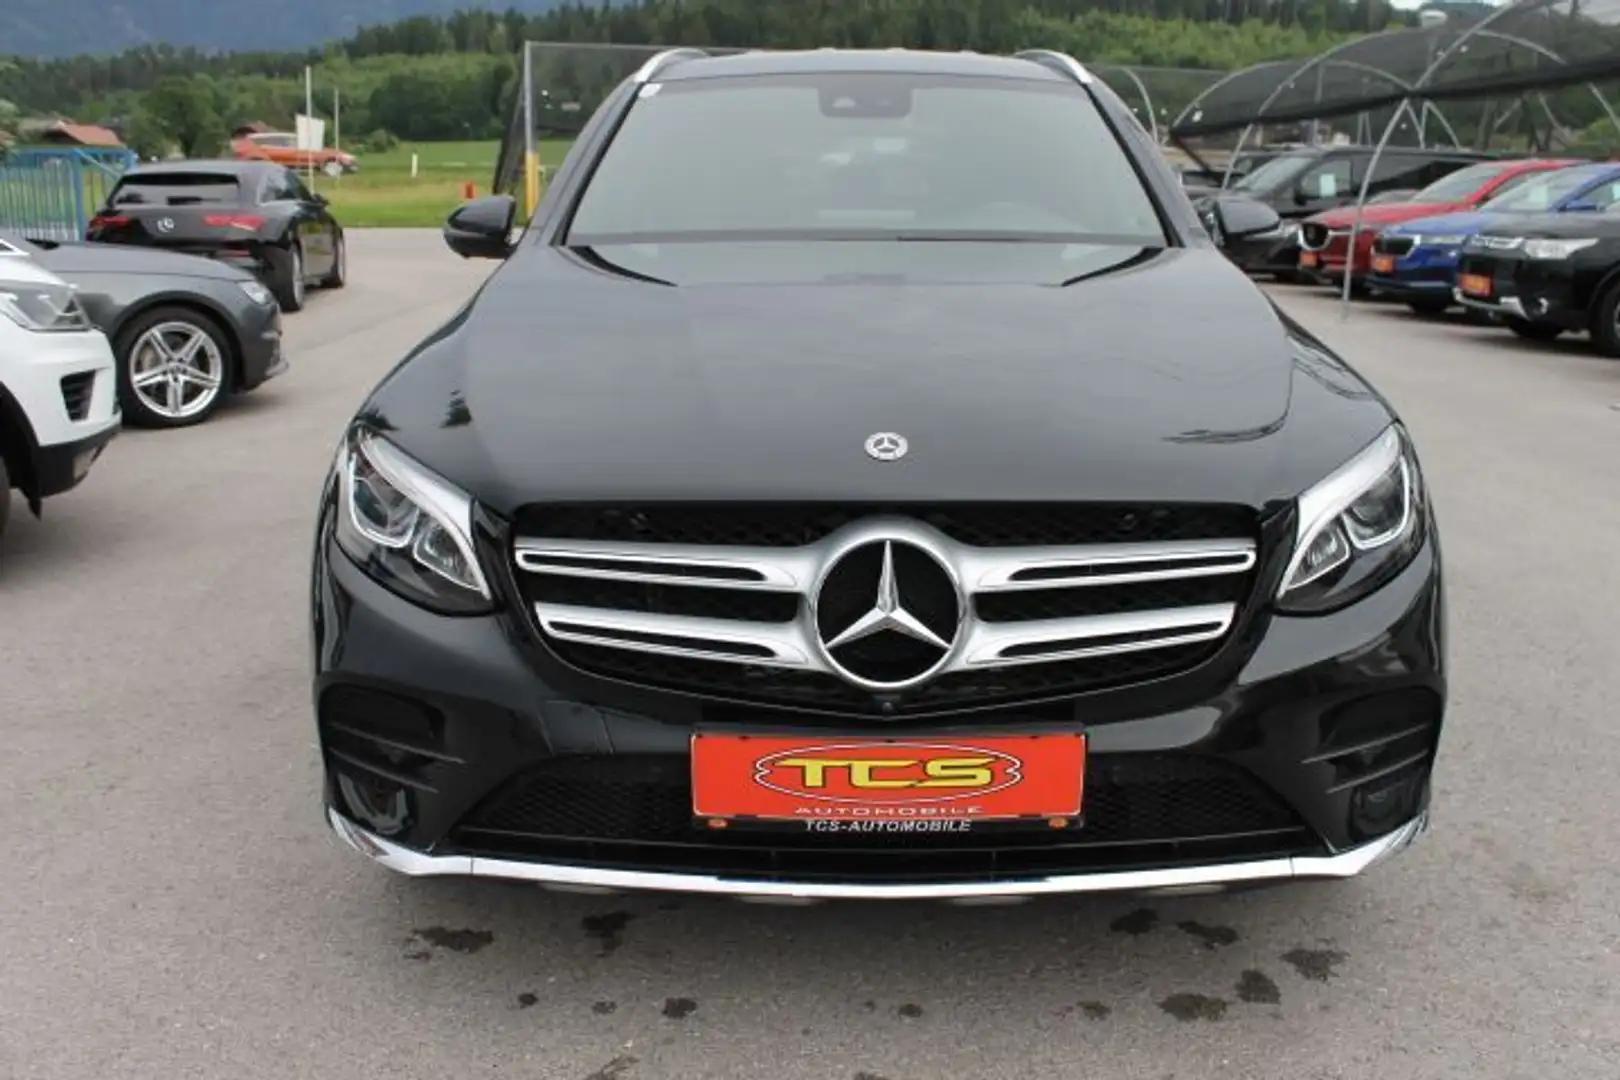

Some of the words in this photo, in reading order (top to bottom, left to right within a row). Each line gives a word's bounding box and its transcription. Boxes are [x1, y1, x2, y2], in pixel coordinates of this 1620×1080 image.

[774, 757, 997, 788] TCS
[794, 806, 984, 816] AUTOMOBILE
[805, 819, 972, 832] TCS-AUTOMOBILE
